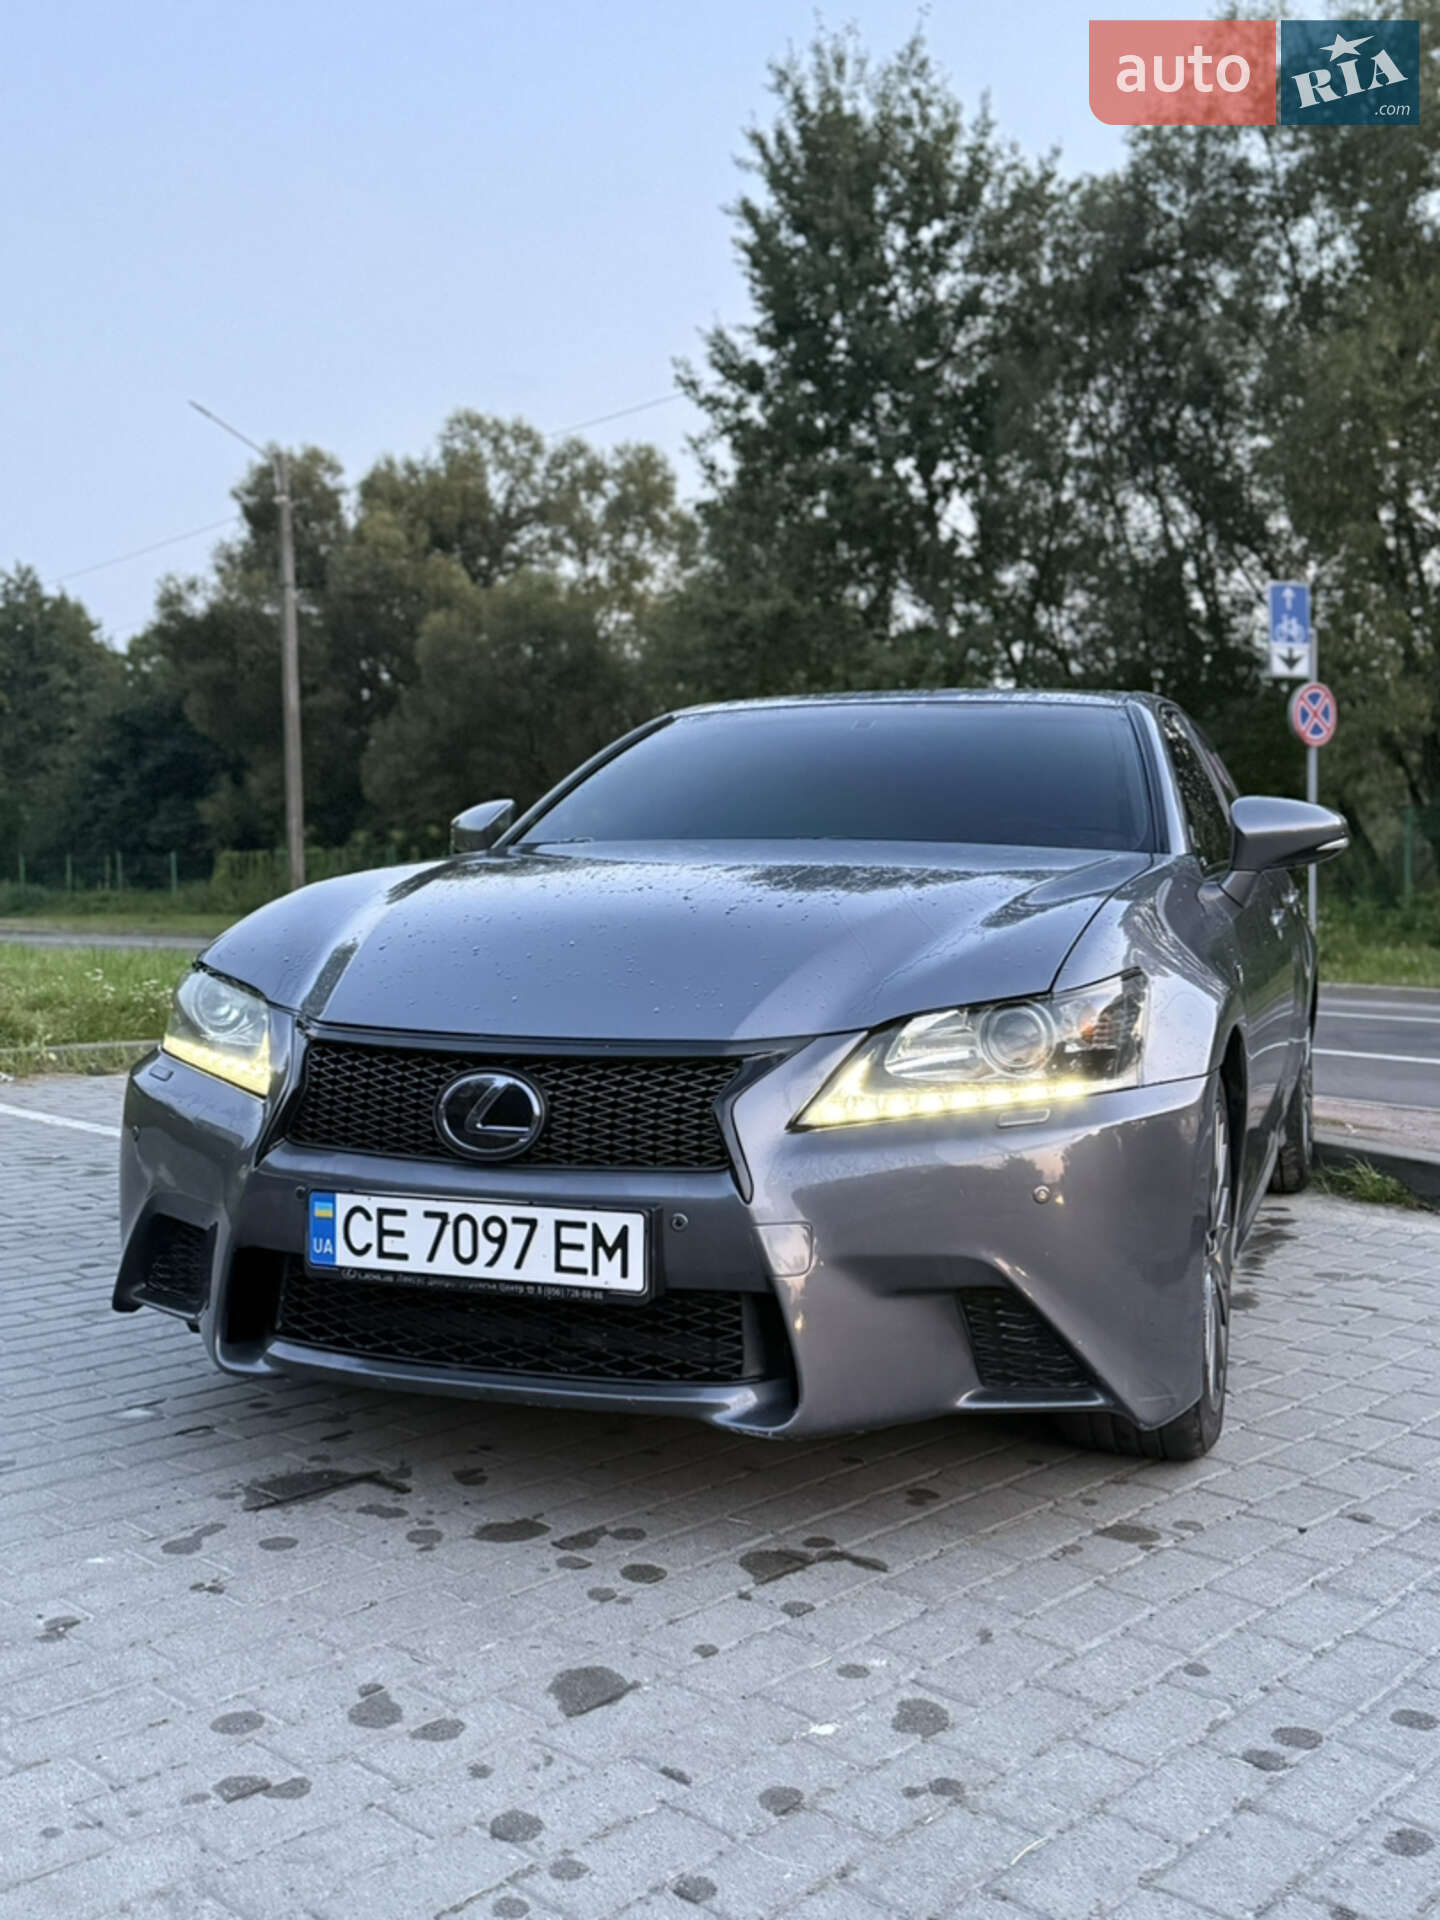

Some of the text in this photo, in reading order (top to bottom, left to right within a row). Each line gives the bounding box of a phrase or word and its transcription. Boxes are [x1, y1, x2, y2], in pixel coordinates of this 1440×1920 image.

[313, 1237, 334, 1255] UA
[343, 1205, 629, 1279] CE 7097 EM
